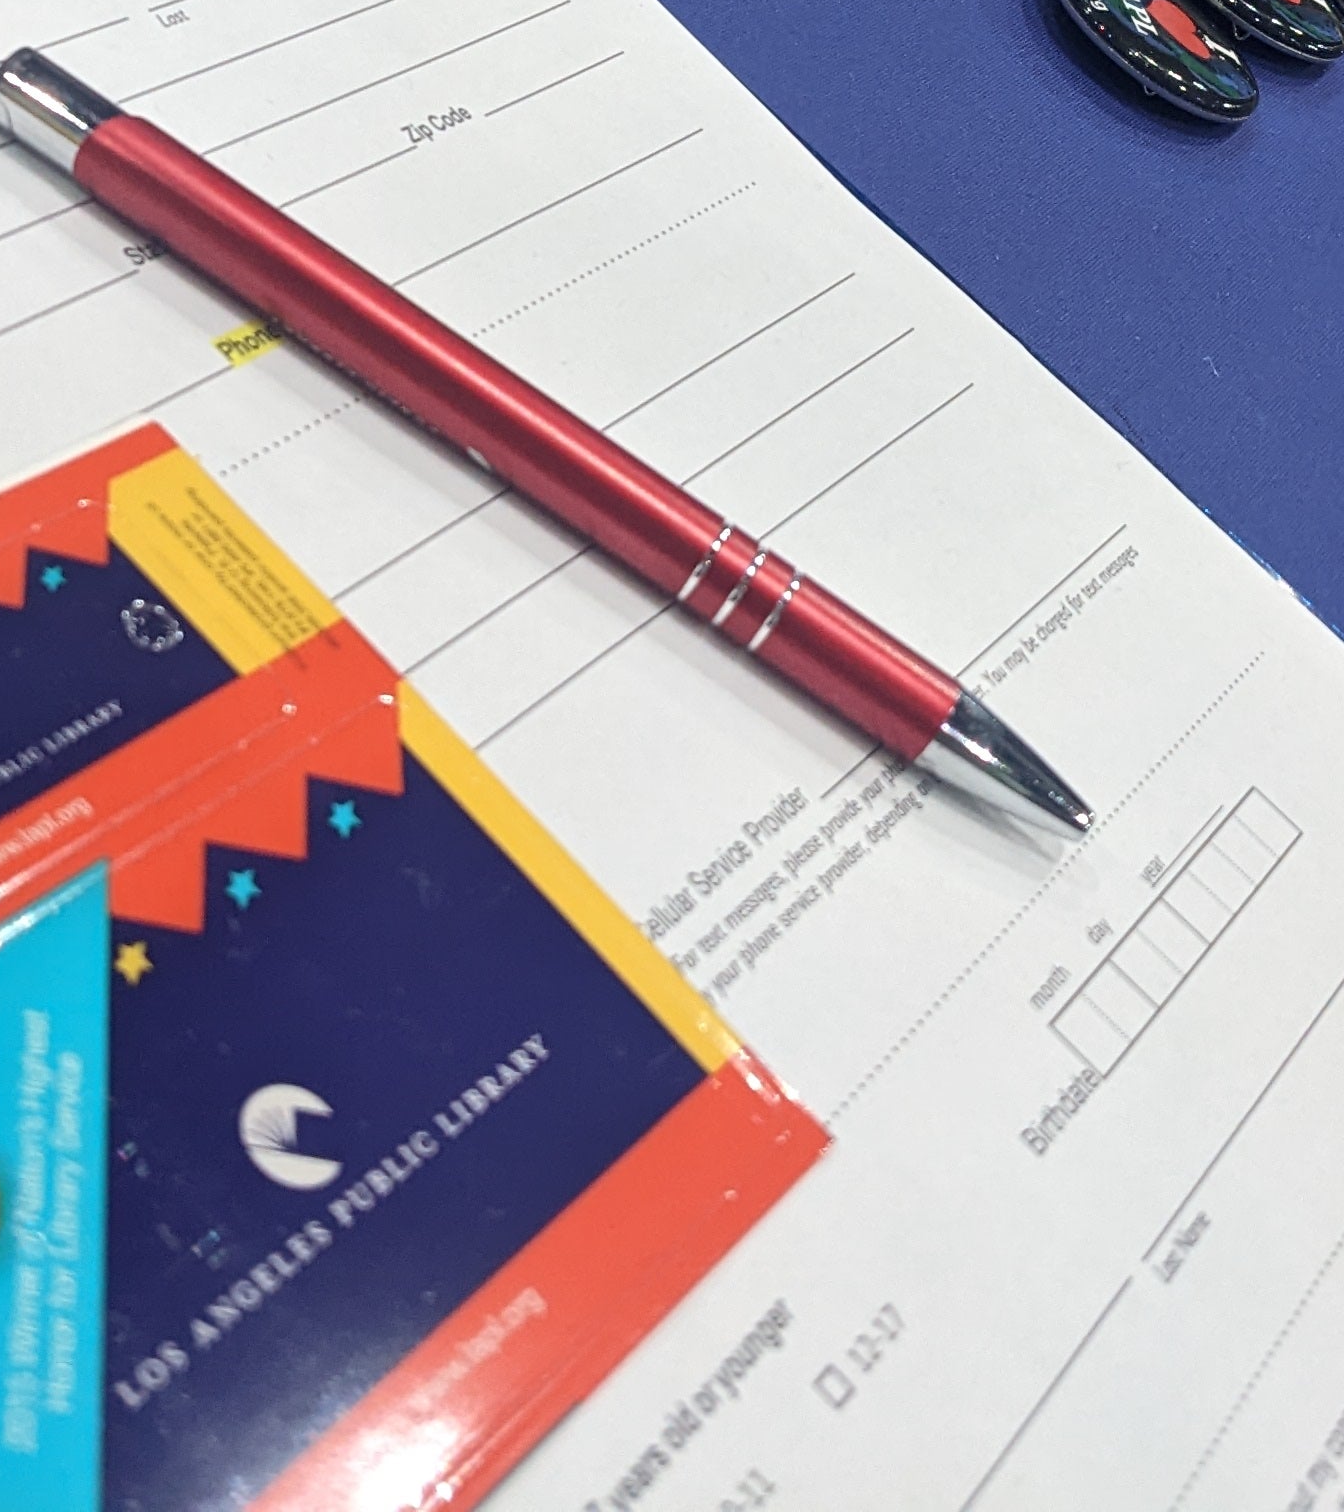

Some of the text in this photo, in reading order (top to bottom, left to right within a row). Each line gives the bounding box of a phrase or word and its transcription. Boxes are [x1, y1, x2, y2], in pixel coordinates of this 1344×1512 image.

[156, 8, 189, 29] Last
[1202, 34, 1240, 66] I
[400, 104, 473, 146] Zip Code
[686, 838, 753, 896] Service
[741, 786, 810, 846] Provider
[1028, 853, 1168, 1012] month day year
[1020, 1066, 1100, 1157] Birthdate
[115, 1031, 552, 1412] LOS ANGELES PUBLIC LIBRARY
[661, 1401, 702, 1449] old
[693, 1379, 726, 1418] or
[714, 1297, 794, 1402] younger
[847, 1301, 906, 1372] 12-17
